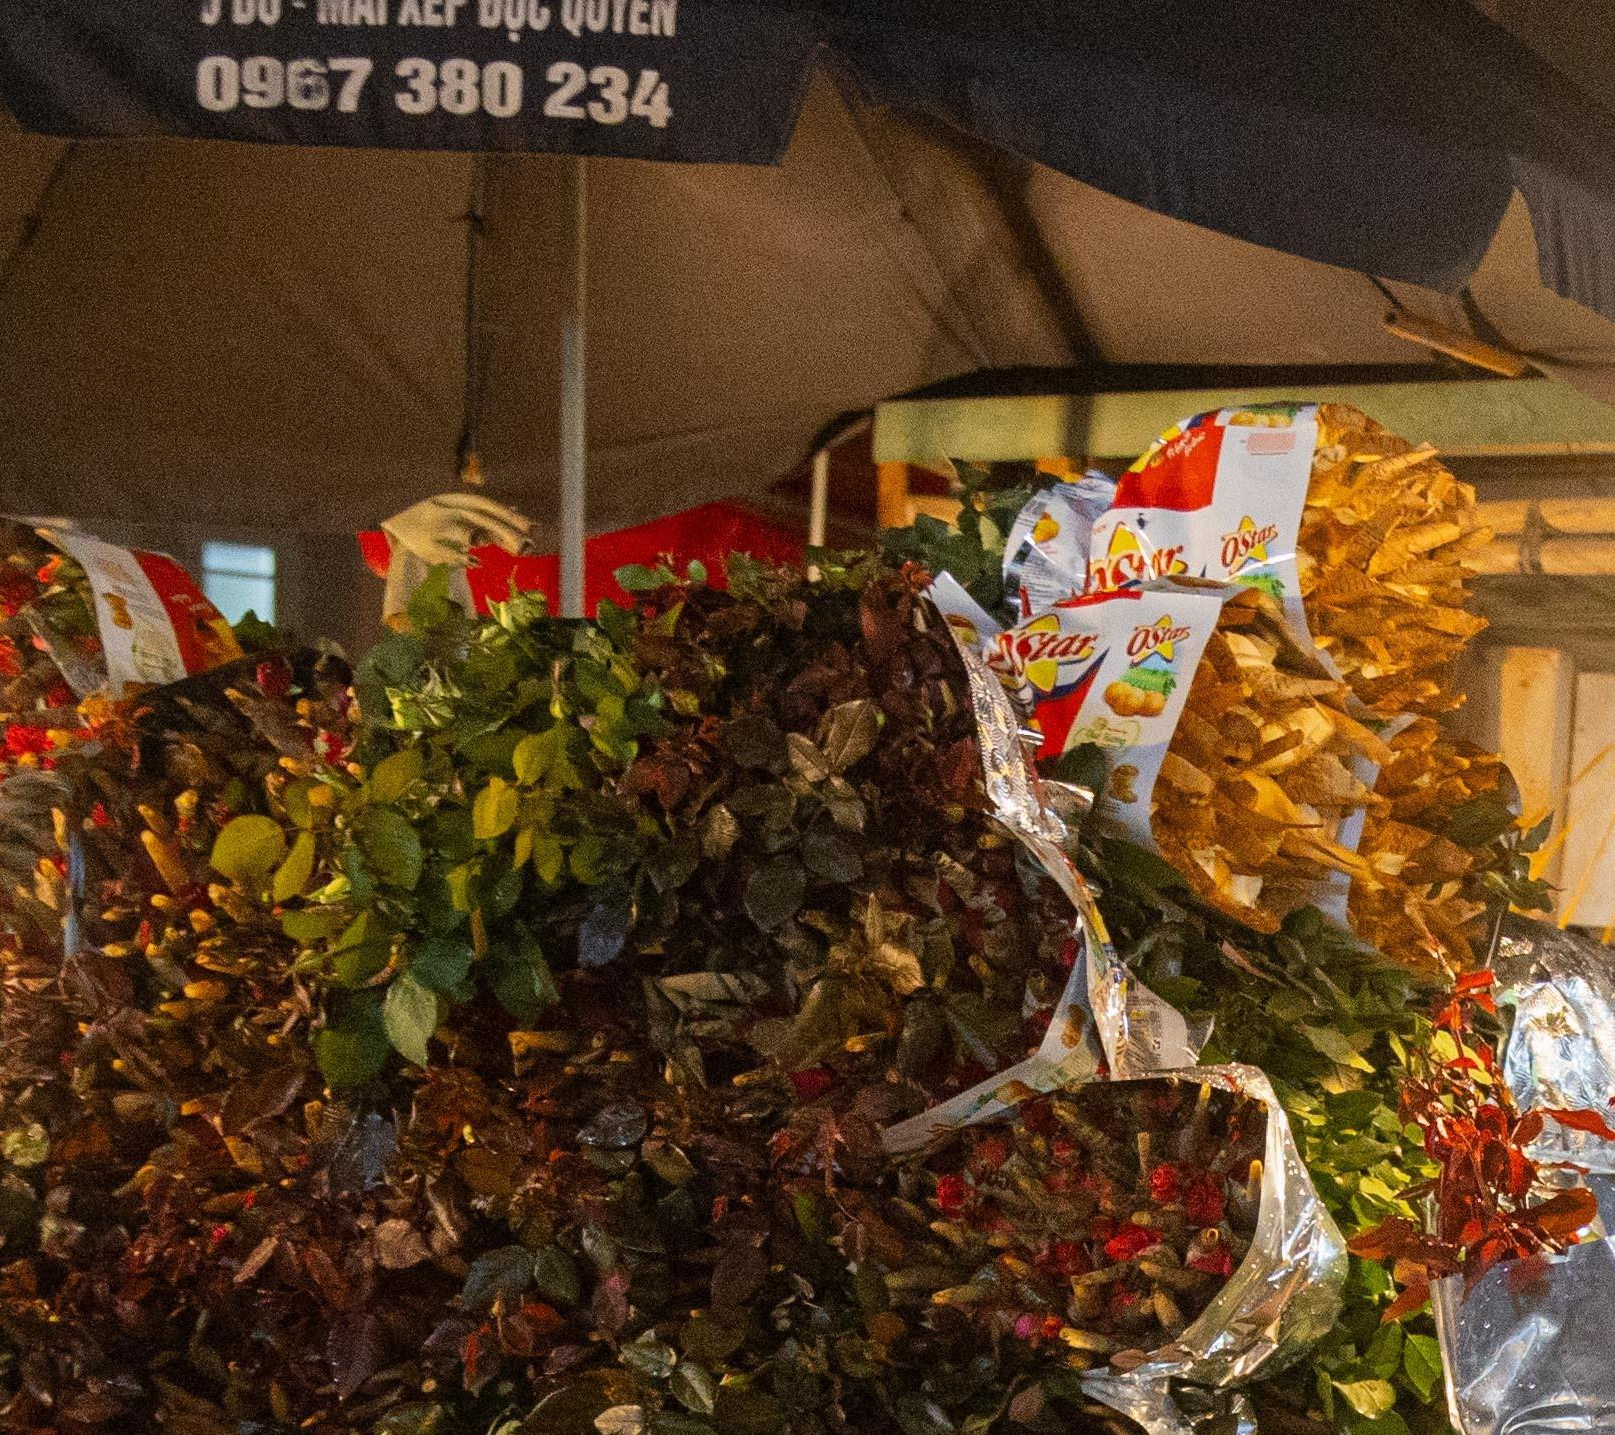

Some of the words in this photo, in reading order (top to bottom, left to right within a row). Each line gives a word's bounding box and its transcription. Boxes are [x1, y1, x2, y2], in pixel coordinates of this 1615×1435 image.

[195, 54, 375, 113] 0967
[393, 56, 525, 119] 380
[542, 60, 674, 129] 234
